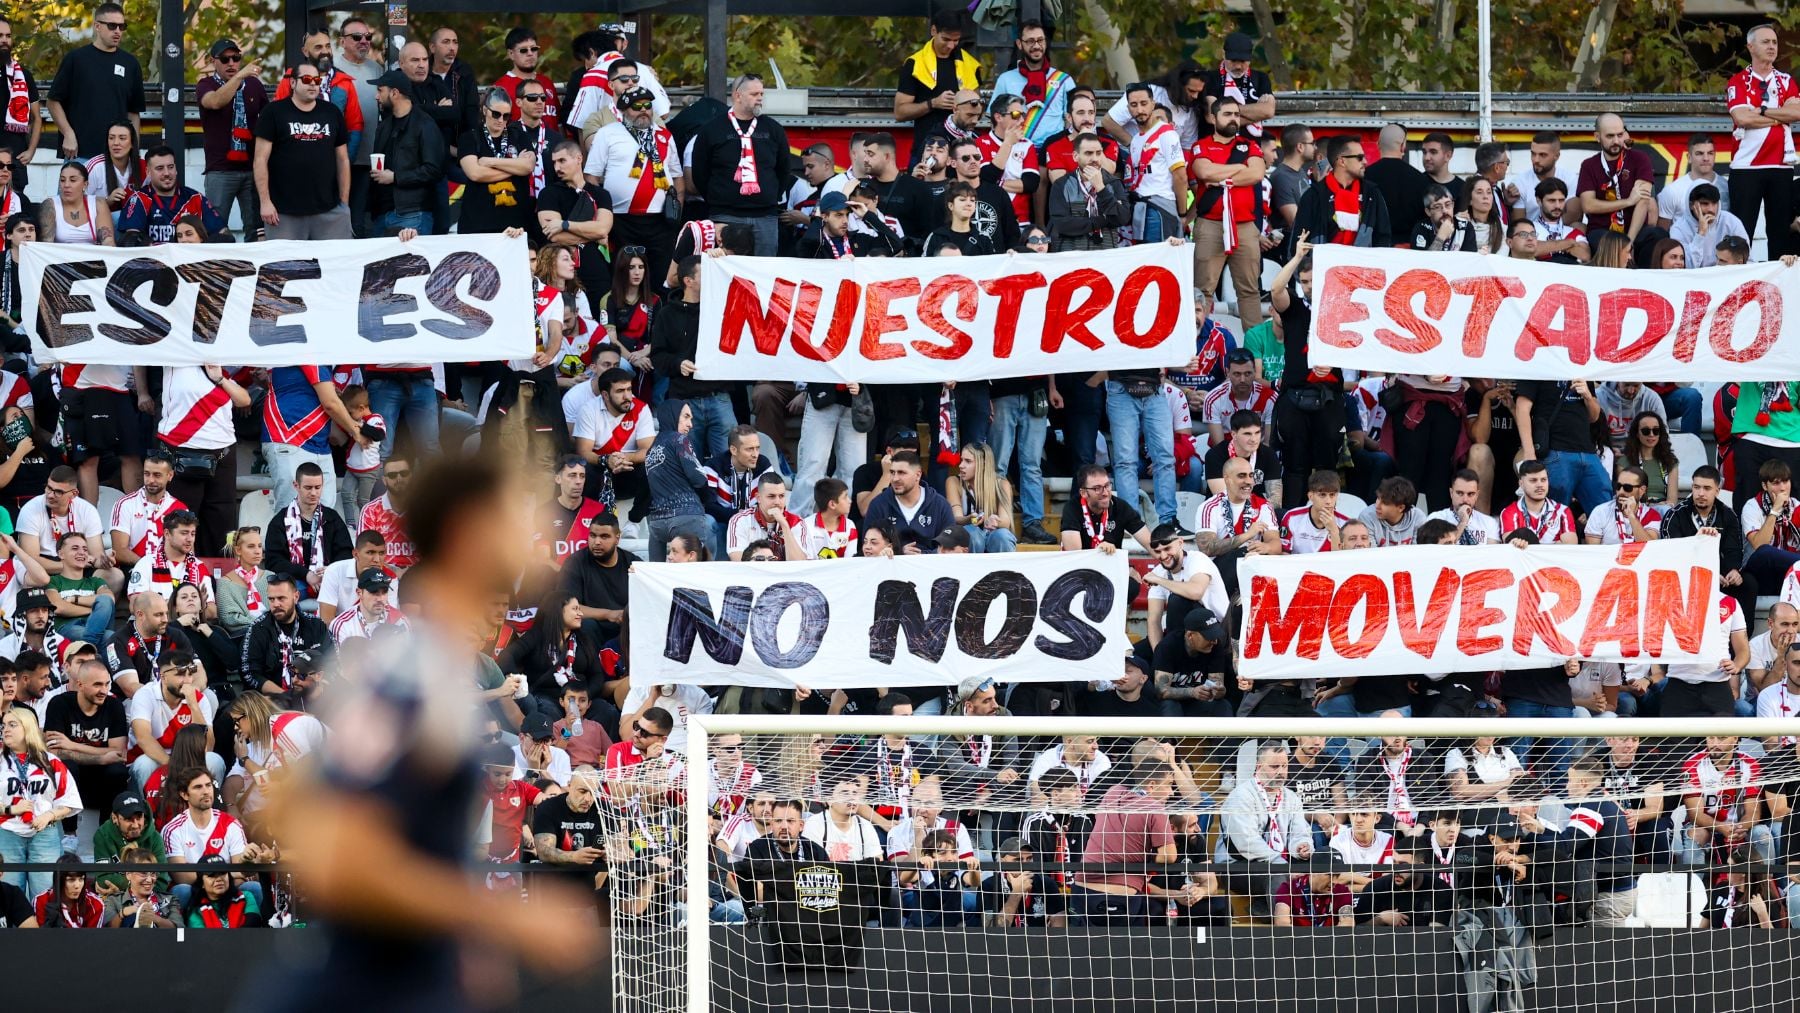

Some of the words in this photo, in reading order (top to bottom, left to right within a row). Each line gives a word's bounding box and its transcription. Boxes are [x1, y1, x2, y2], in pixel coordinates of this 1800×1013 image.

[288, 122, 331, 136] 1924
[36, 257, 322, 348] ESTE
[357, 251, 501, 343] ES
[718, 264, 1182, 363] NUESTRO
[1315, 264, 1784, 366] ESTADIO
[509, 609, 533, 619] FILA
[662, 580, 830, 669] NO
[868, 568, 1115, 665] NOS
[1243, 541, 1713, 661] MOVERÁN
[797, 873, 840, 888] ANTIFA
